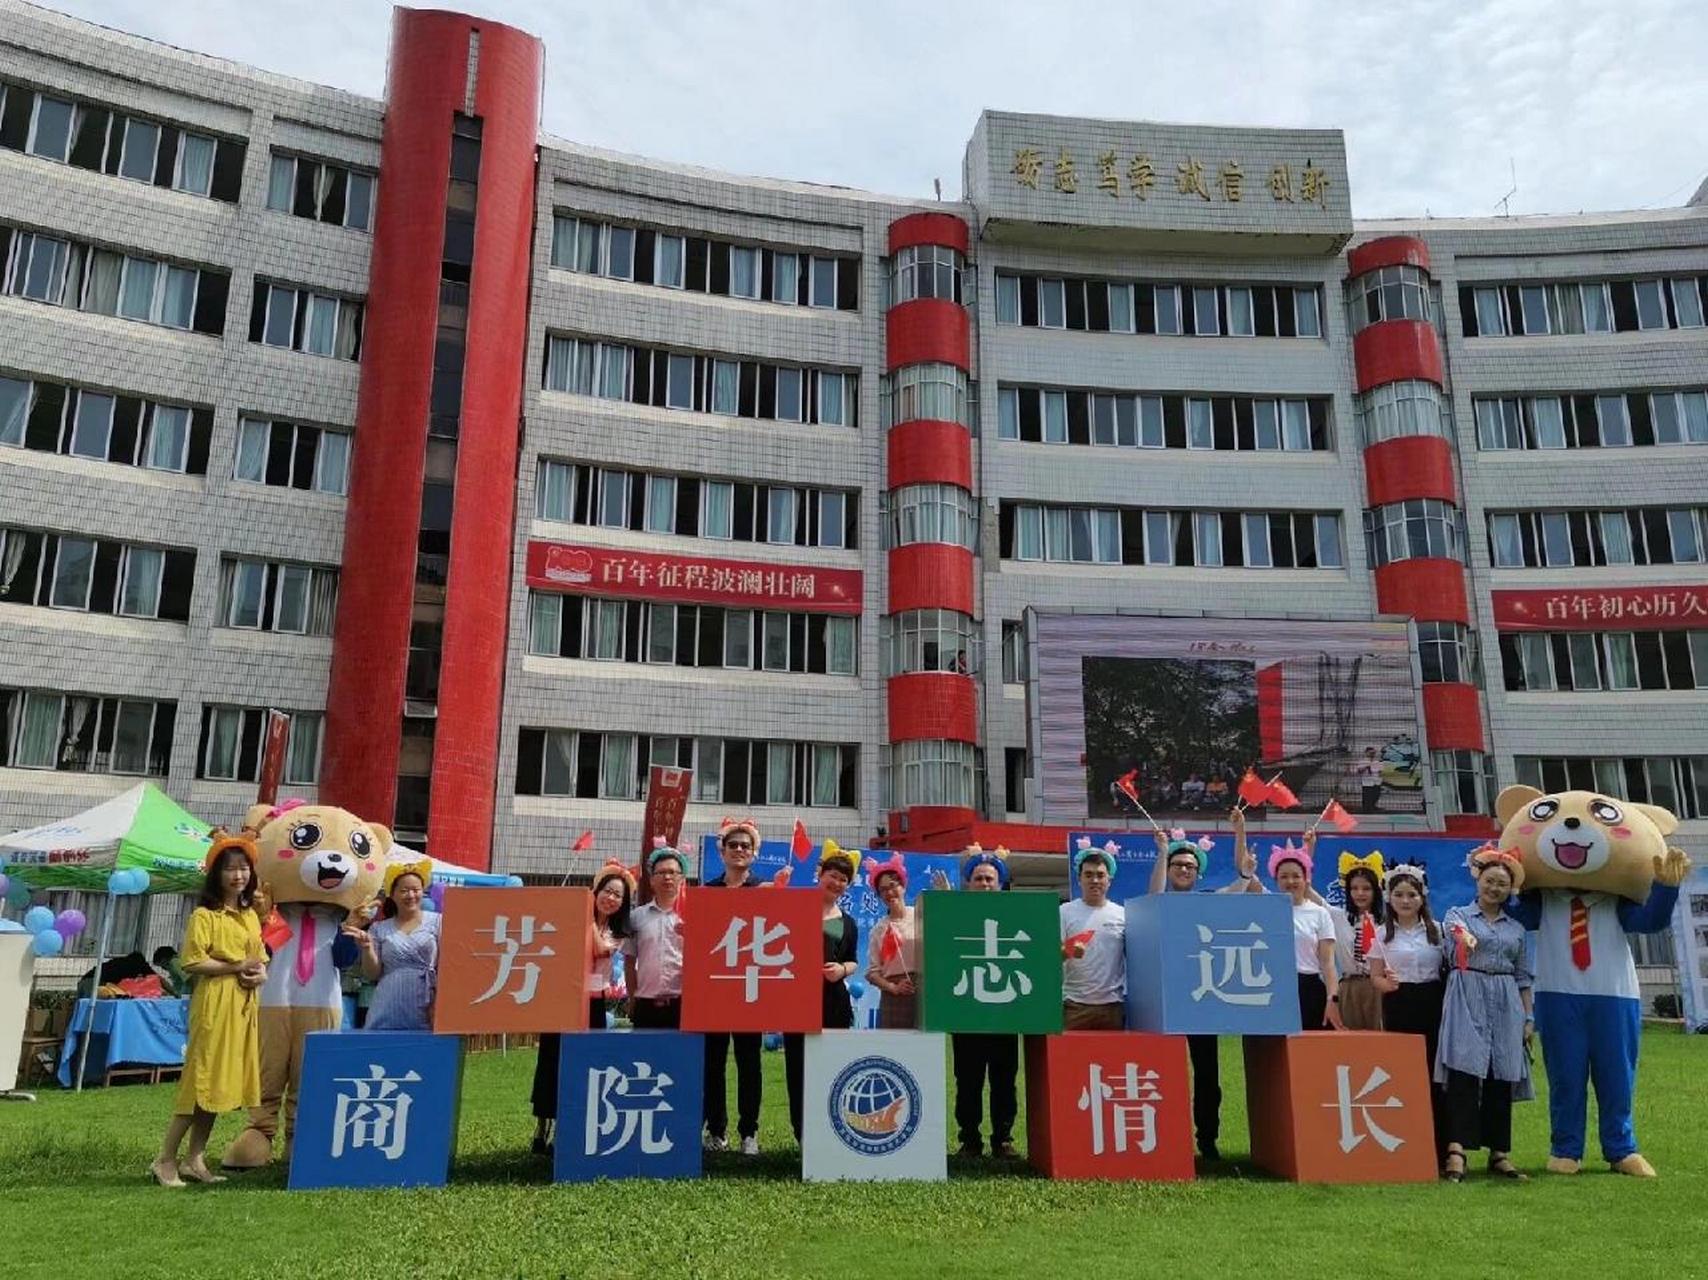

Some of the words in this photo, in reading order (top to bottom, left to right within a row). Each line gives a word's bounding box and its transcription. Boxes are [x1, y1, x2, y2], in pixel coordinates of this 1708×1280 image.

[1267, 158, 1331, 211] 创新
[602, 557, 816, 599] 百年征程波澜壮阔
[1546, 591, 1708, 621] 百年初心历久
[469, 915, 557, 1005] 芳
[709, 915, 796, 1004] 华
[952, 918, 1034, 1005] 志
[1186, 921, 1274, 1007] 远
[330, 1063, 424, 1161] 商
[584, 1061, 676, 1157] 院
[1077, 1061, 1165, 1156] 情
[1320, 1063, 1406, 1155] 长
